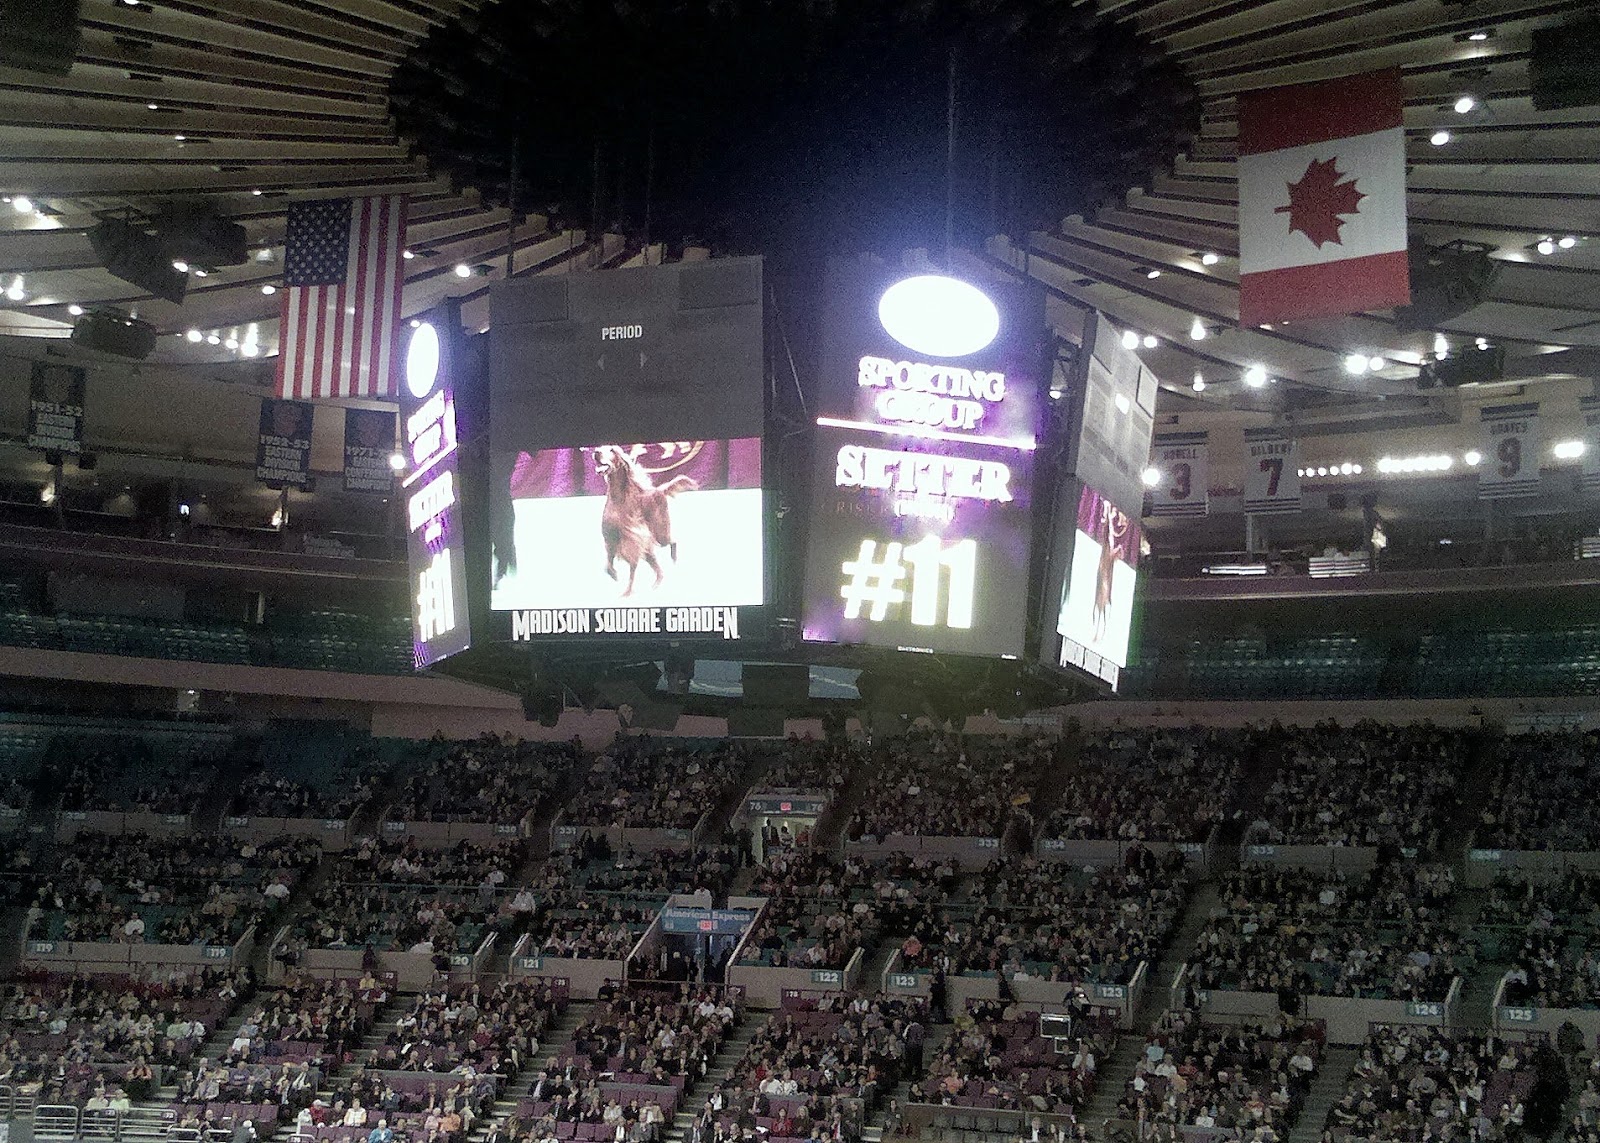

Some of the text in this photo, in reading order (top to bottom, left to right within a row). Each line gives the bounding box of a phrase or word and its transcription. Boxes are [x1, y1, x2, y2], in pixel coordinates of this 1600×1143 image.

[602, 325, 643, 341] PERIOD
[858, 356, 1006, 402] SPORTING
[876, 390, 984, 430] GROUP
[260, 434, 310, 450] 1952-53
[265, 445, 302, 461] EASTERN
[1498, 437, 1522, 479] 9
[256, 466, 307, 483] CHAMPIONS
[836, 445, 1014, 503] SETTER
[1169, 462, 1191, 500] 3
[1260, 458, 1284, 497] 7
[841, 534, 977, 630] #11
[512, 606, 740, 641] MADISON SQUARE GARDEN
[666, 908, 750, 922] American Express
[523, 958, 540, 969] 121
[819, 971, 839, 982] 122
[895, 976, 915, 987] 123
[1102, 987, 1123, 998] 123
[1415, 1003, 1438, 1015] 124
[1508, 1008, 1533, 1021] 125
